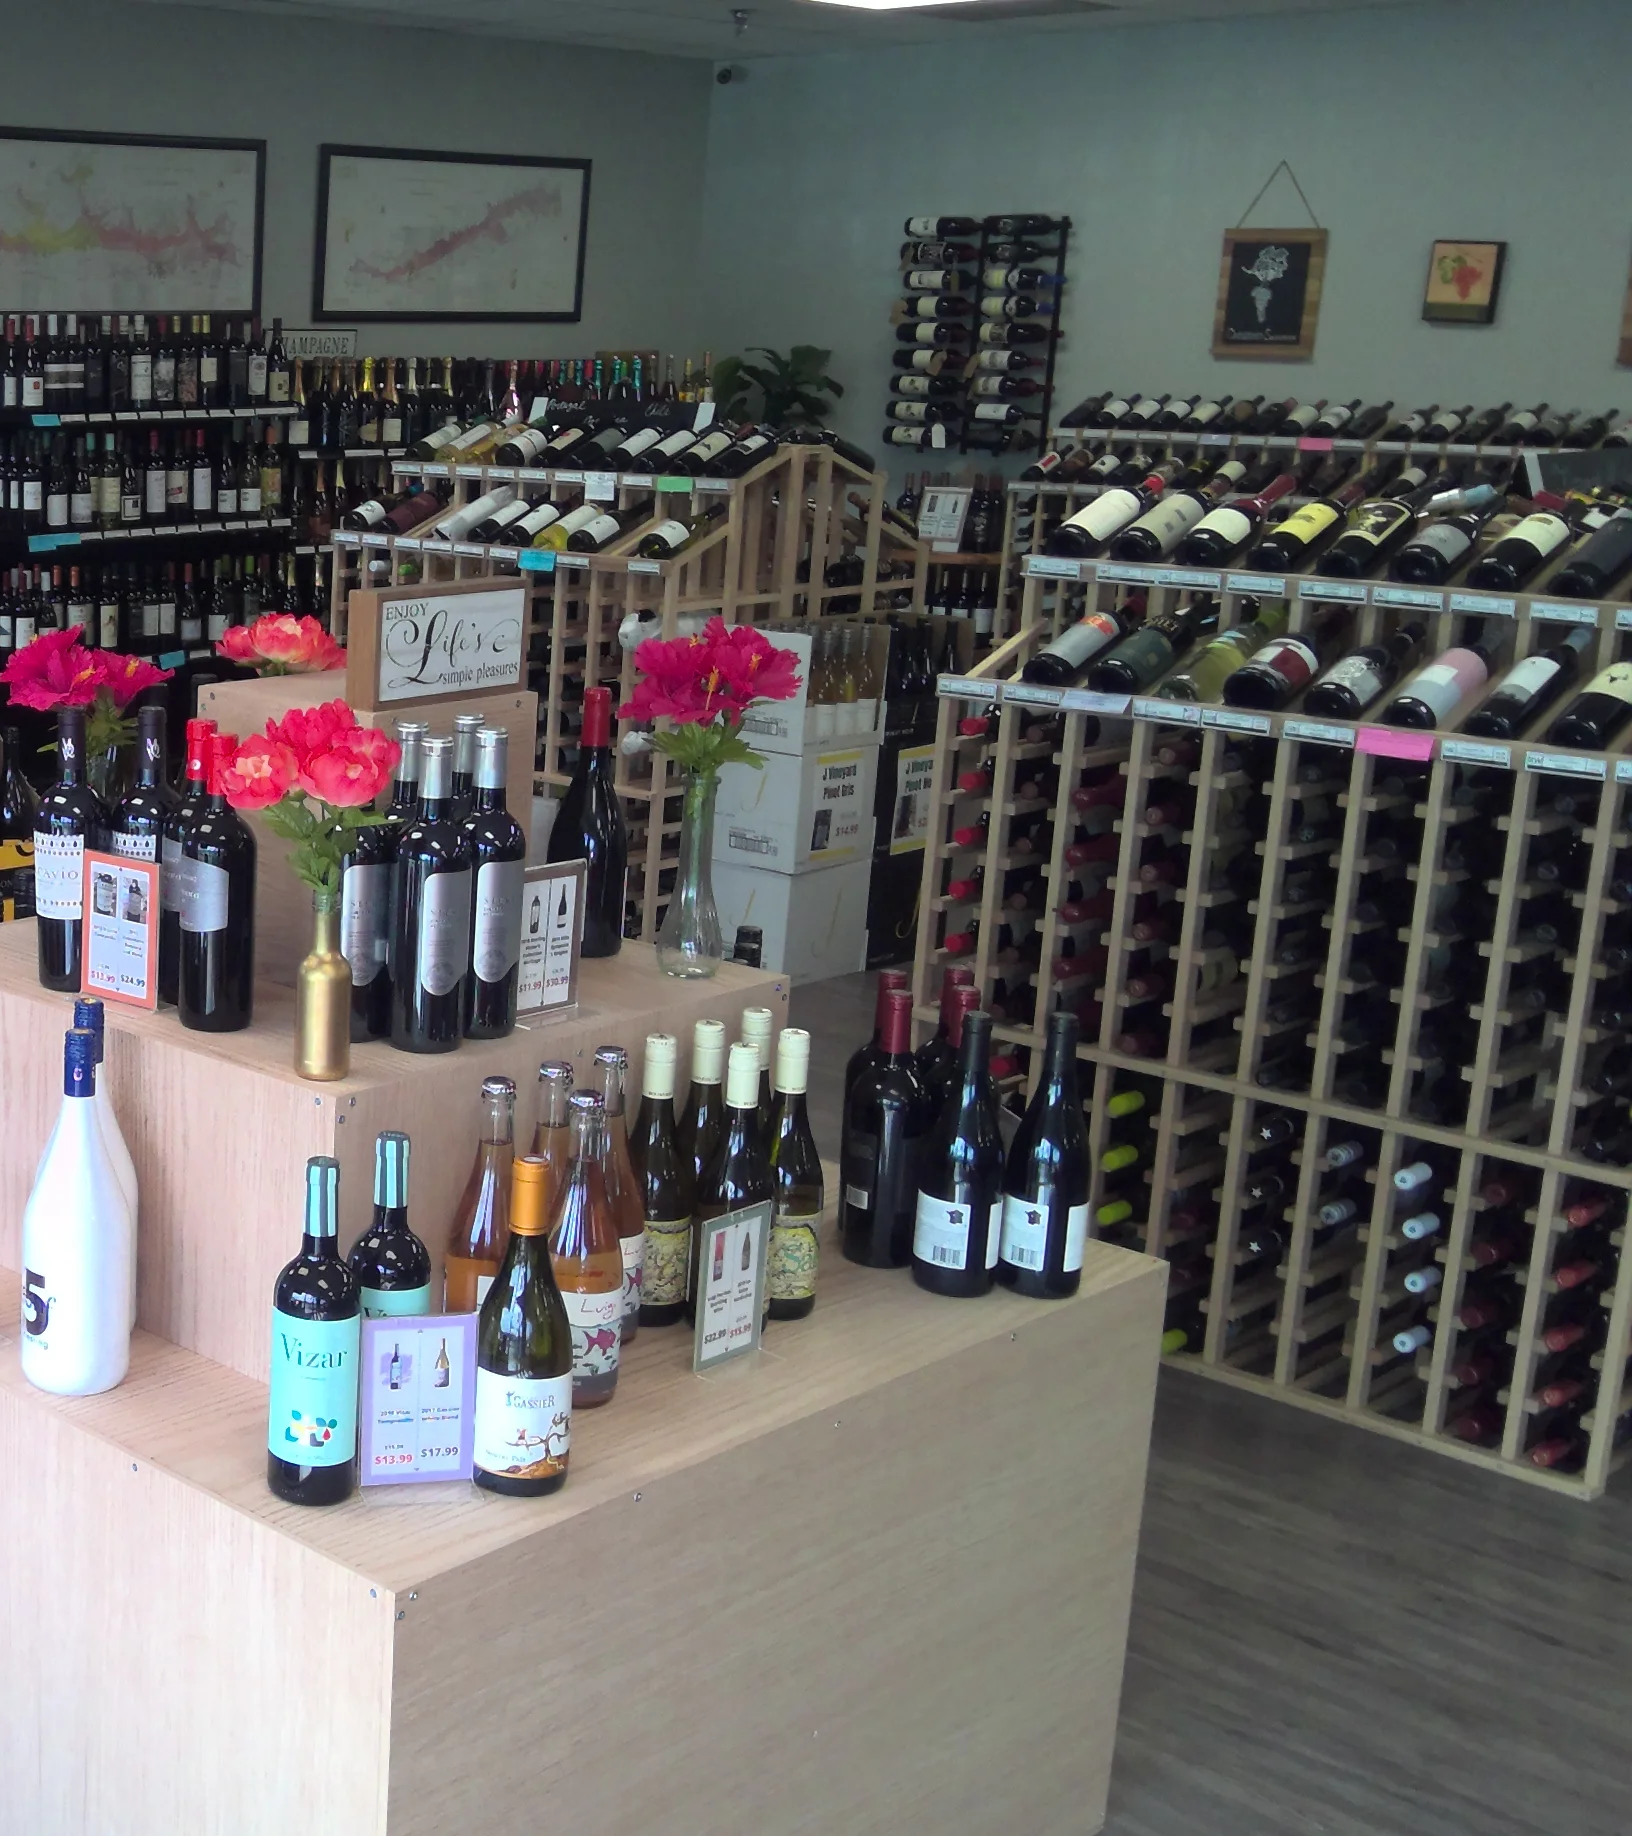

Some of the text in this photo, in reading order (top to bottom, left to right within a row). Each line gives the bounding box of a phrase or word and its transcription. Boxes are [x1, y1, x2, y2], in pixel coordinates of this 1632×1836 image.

[282, 337, 349, 354] HAMPAGNE
[645, 403, 670, 417] Chile
[385, 602, 429, 621] ENJOY
[442, 661, 518, 687] simple pleasures
[25, 1267, 49, 1336] 5
[280, 1333, 348, 1369] Vizar
[513, 1394, 555, 1409] GASSIER
[375, 1454, 413, 1465] $13.99
[420, 1446, 459, 1458] $17.99
